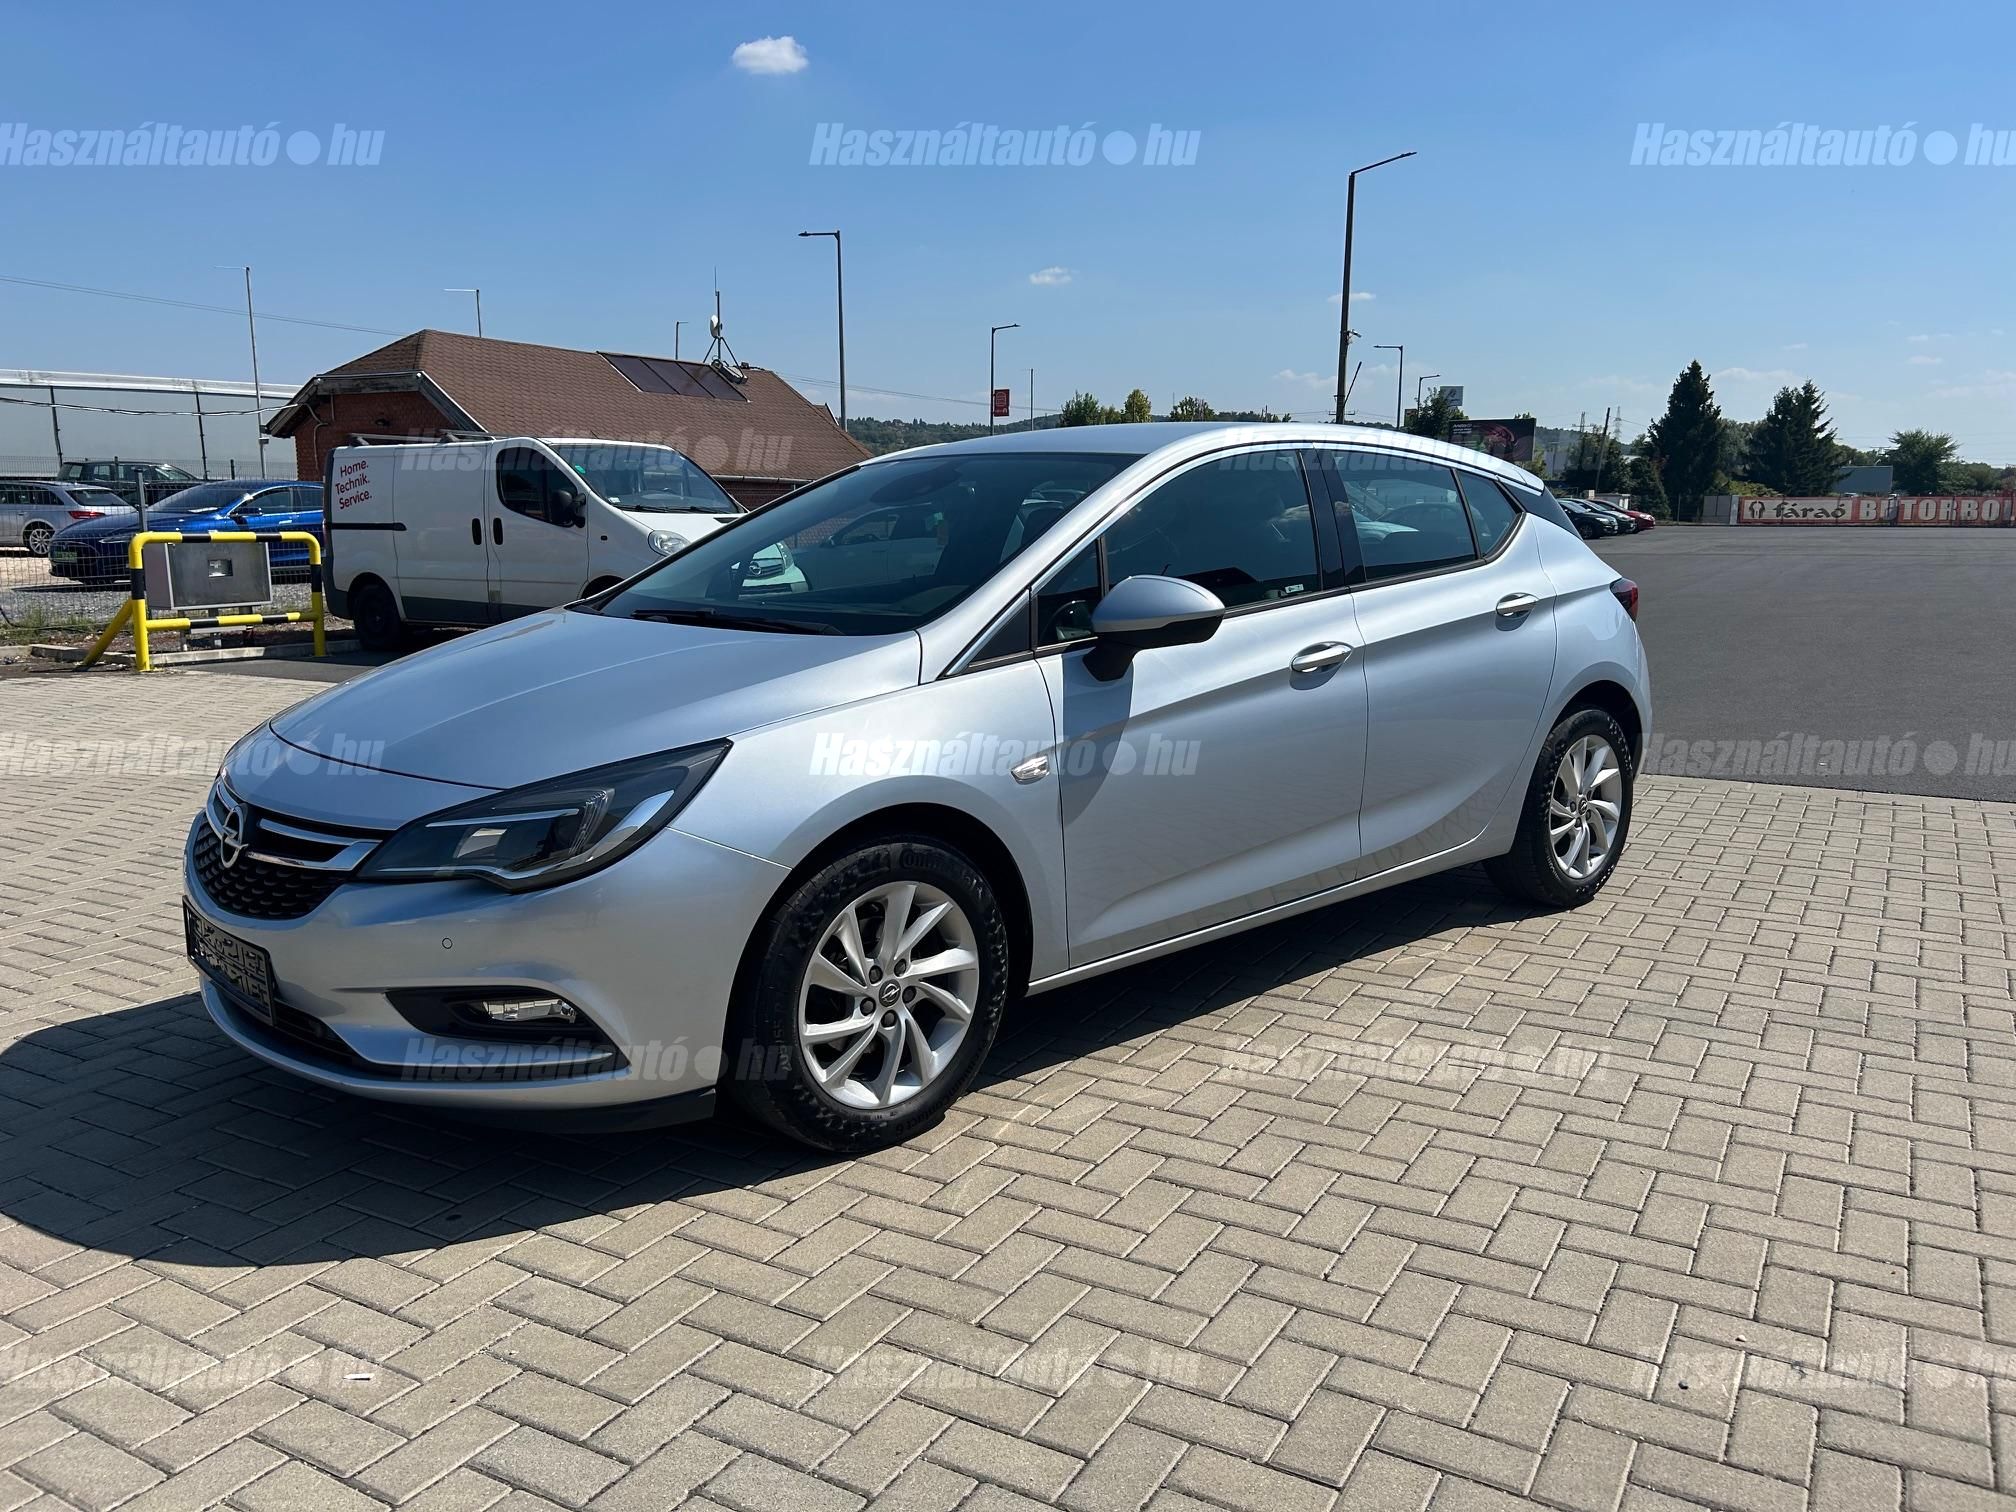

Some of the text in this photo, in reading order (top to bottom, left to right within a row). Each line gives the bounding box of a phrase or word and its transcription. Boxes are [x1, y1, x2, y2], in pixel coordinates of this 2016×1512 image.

[340, 460, 369, 478] Home.
[335, 473, 371, 495] Technik.
[339, 490, 373, 510] Service.
[1773, 501, 1847, 519] fáraó
